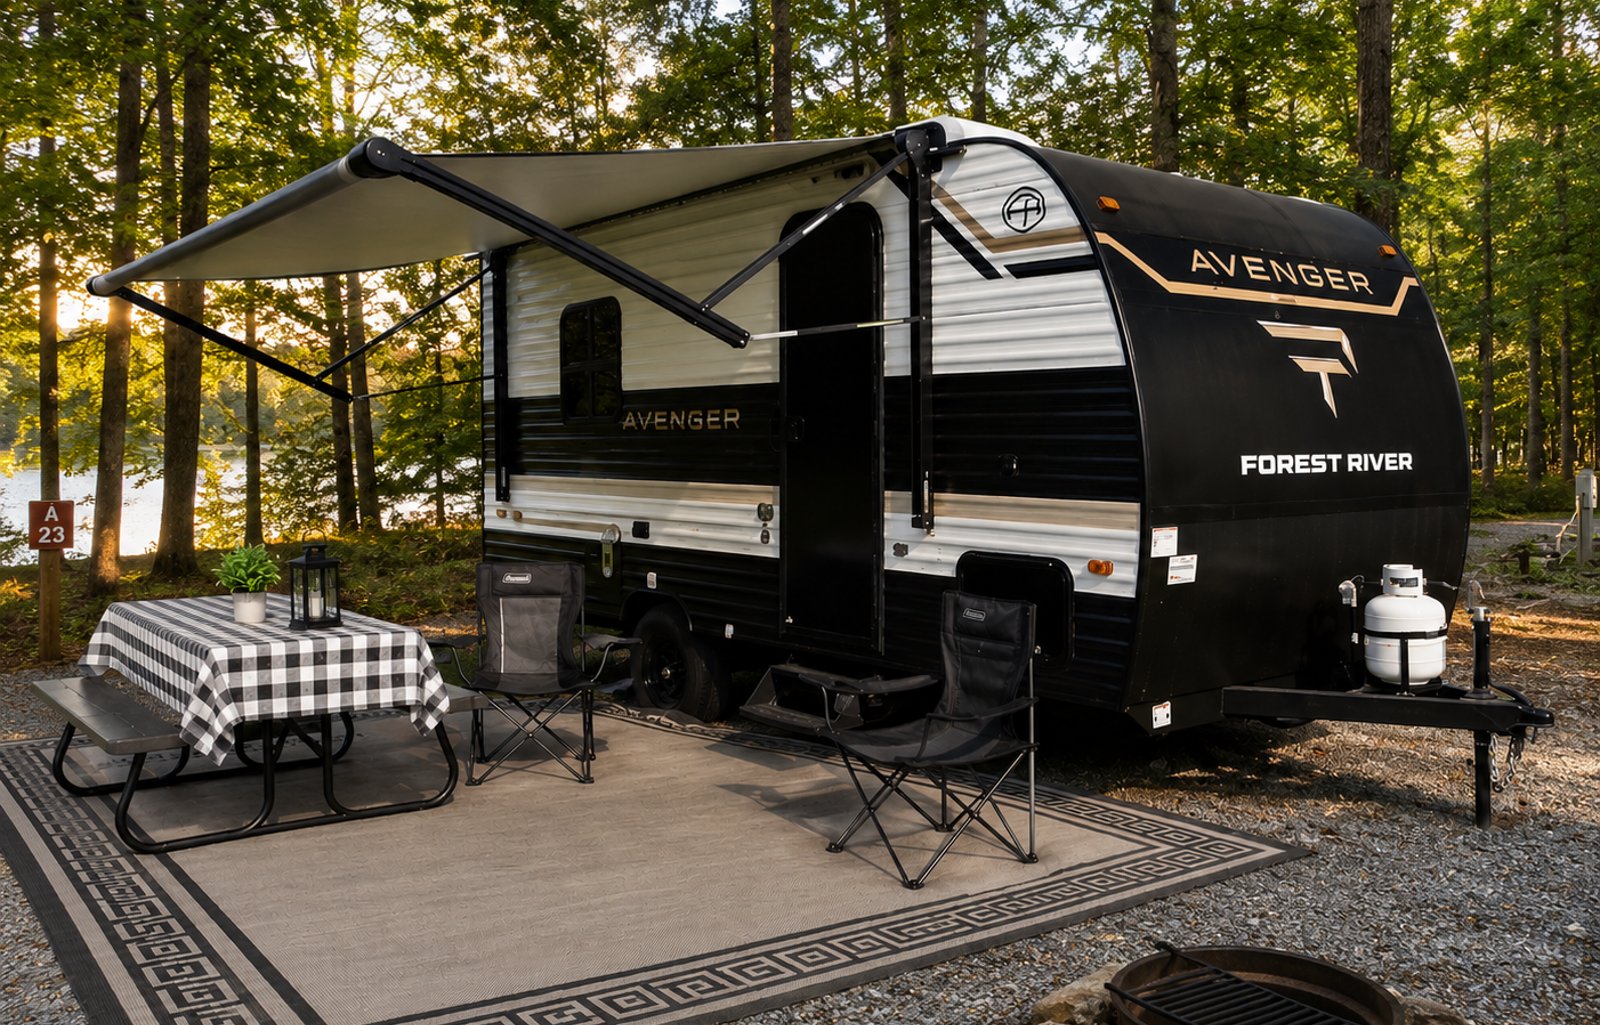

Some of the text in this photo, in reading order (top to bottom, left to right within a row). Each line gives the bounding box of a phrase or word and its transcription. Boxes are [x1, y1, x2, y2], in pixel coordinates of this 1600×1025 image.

[1190, 248, 1375, 295] AVENGER
[622, 408, 740, 431] AVENGER
[1241, 452, 1413, 475] FOREST RIVER
[44, 505, 59, 522] A
[38, 526, 65, 544] 23
